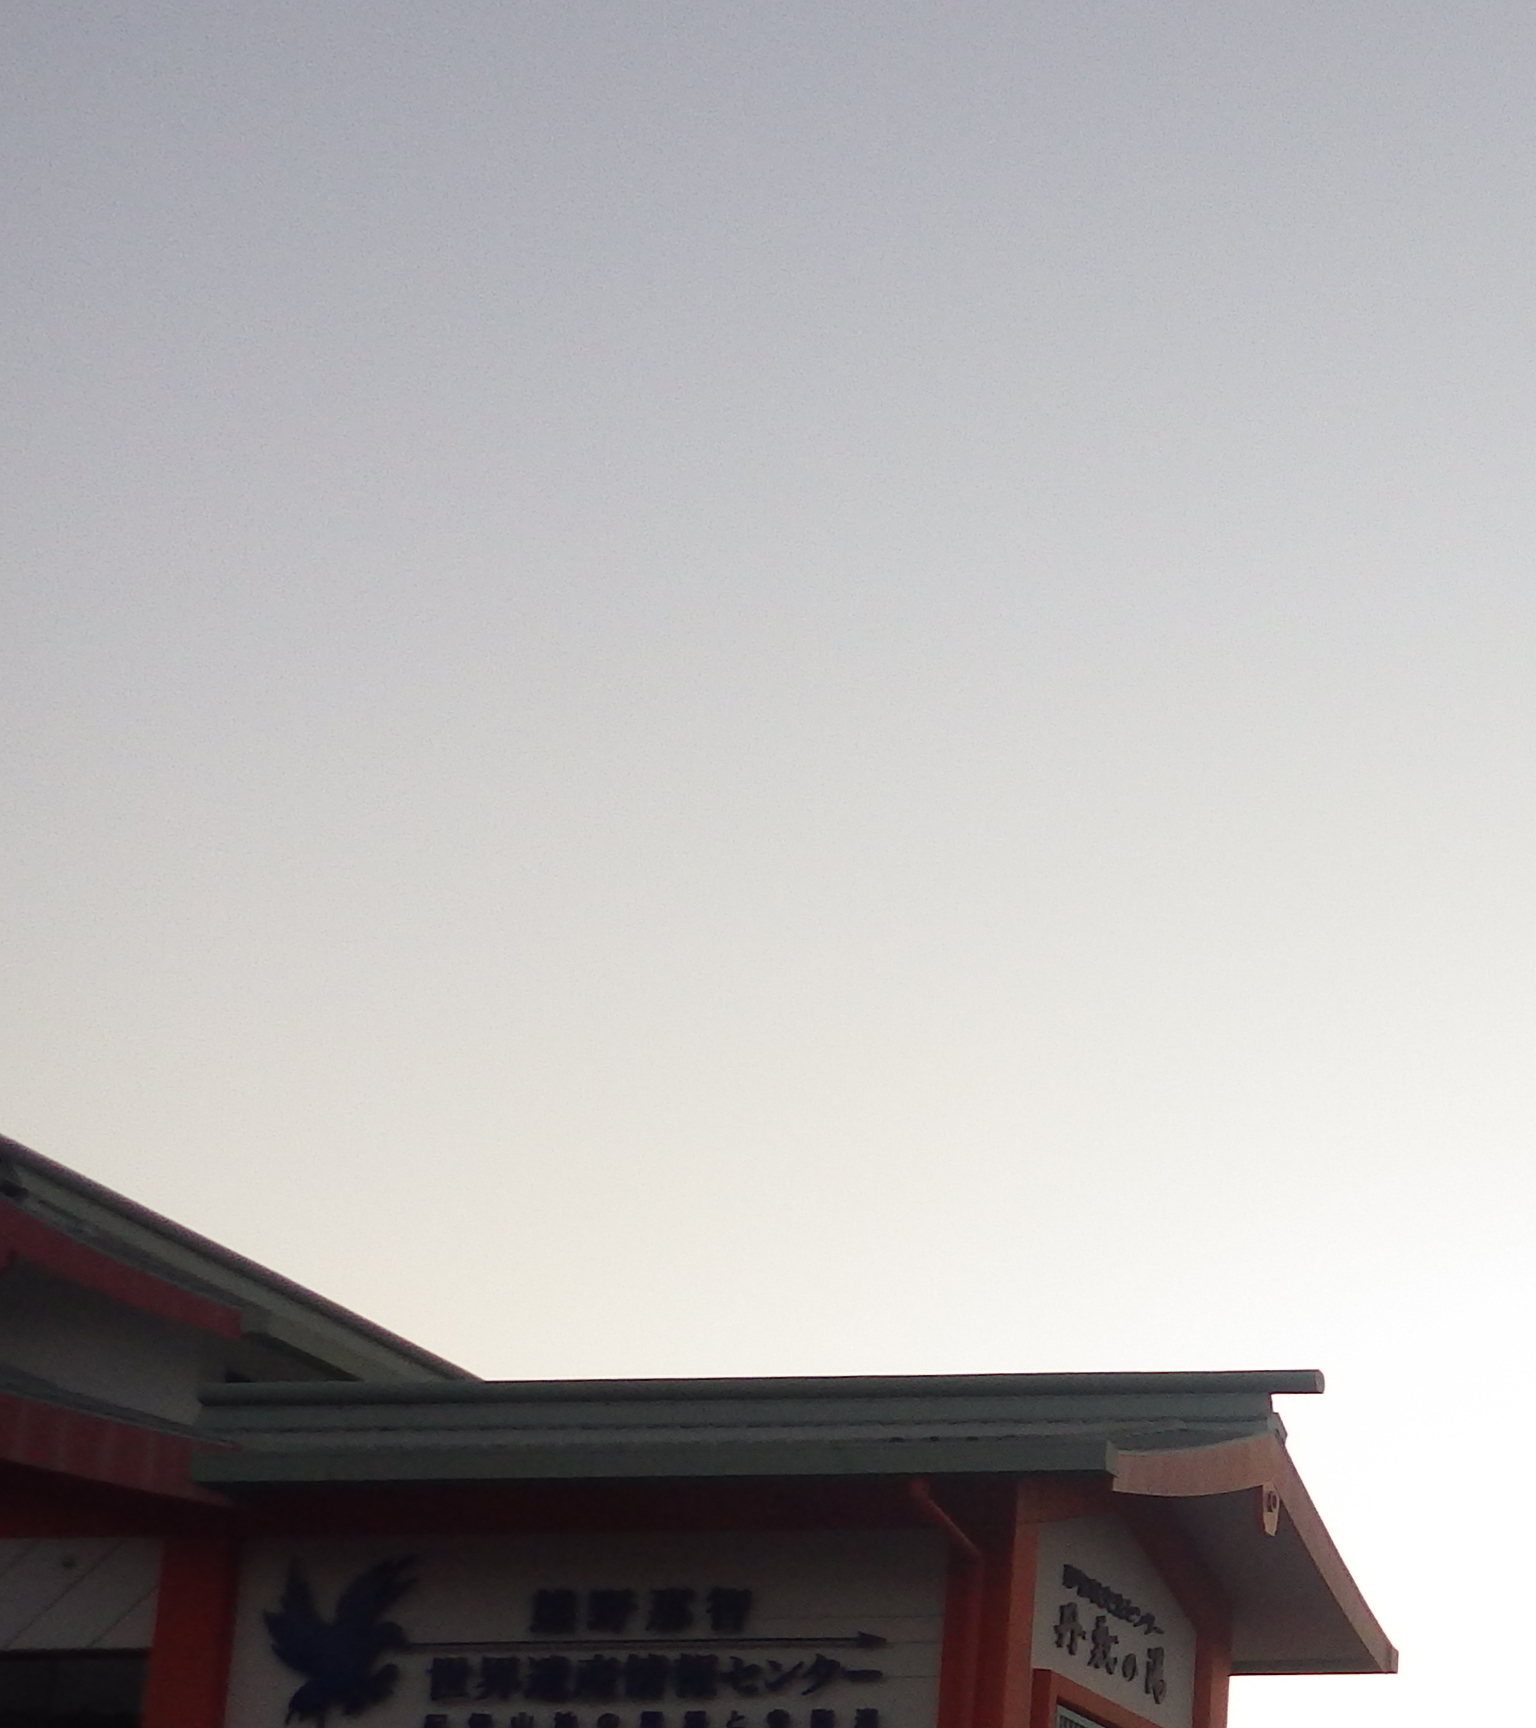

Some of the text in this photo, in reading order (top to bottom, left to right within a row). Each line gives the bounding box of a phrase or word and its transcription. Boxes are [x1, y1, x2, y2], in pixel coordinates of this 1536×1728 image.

[430, 1653, 883, 1701] 世界遺産情報センター
